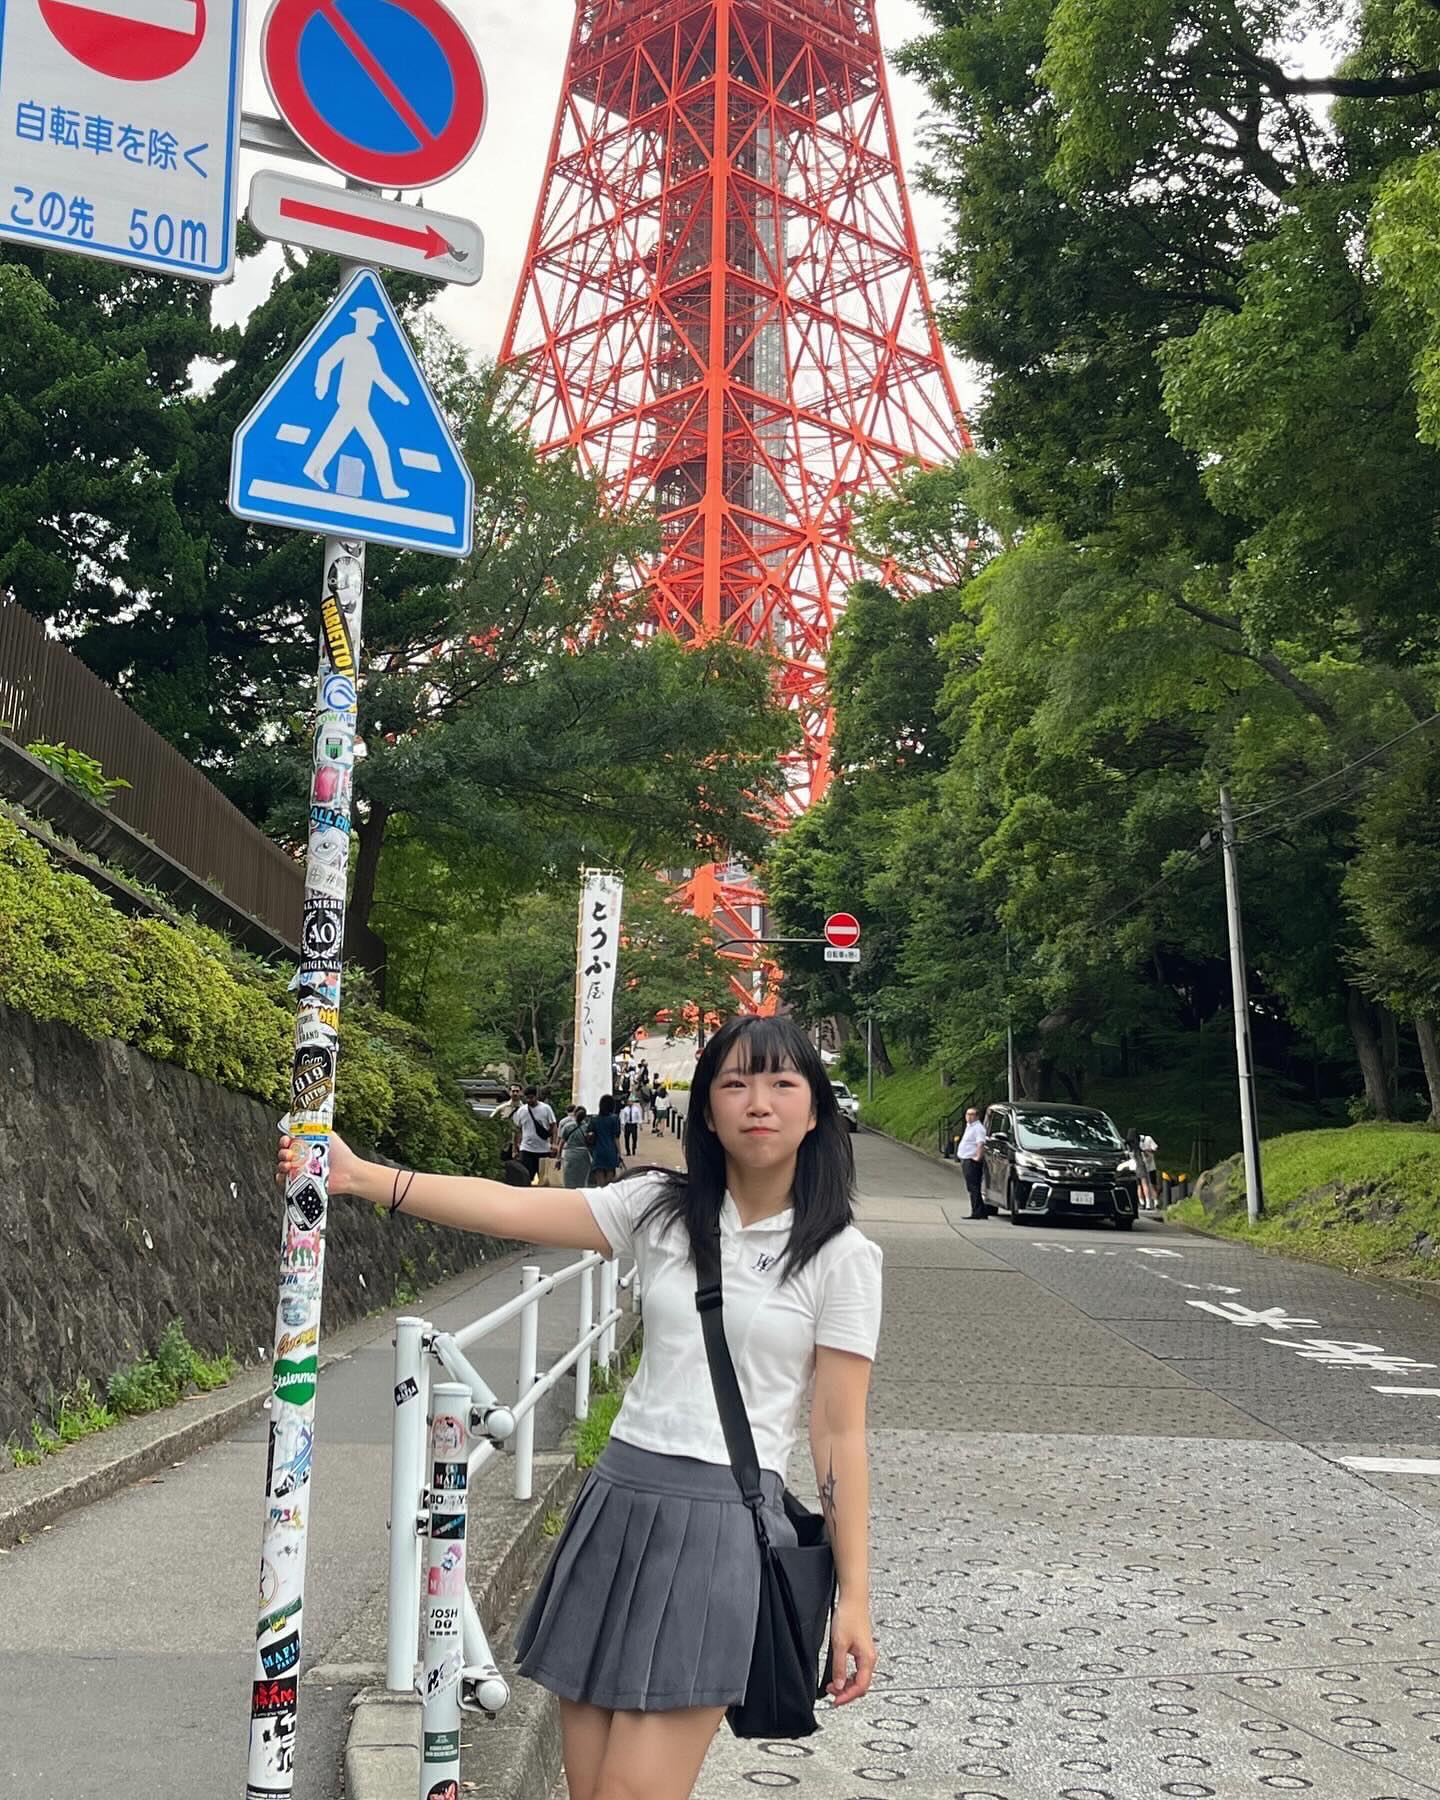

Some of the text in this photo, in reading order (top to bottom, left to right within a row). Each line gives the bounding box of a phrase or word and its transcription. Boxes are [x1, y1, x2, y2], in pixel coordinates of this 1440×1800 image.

[16, 100, 209, 178] 自転車を除く
[10, 186, 207, 263] この先 50m
[308, 922, 336, 943] AO
[295, 1066, 323, 1092] 819
[430, 1608, 458, 1618] JOSH
